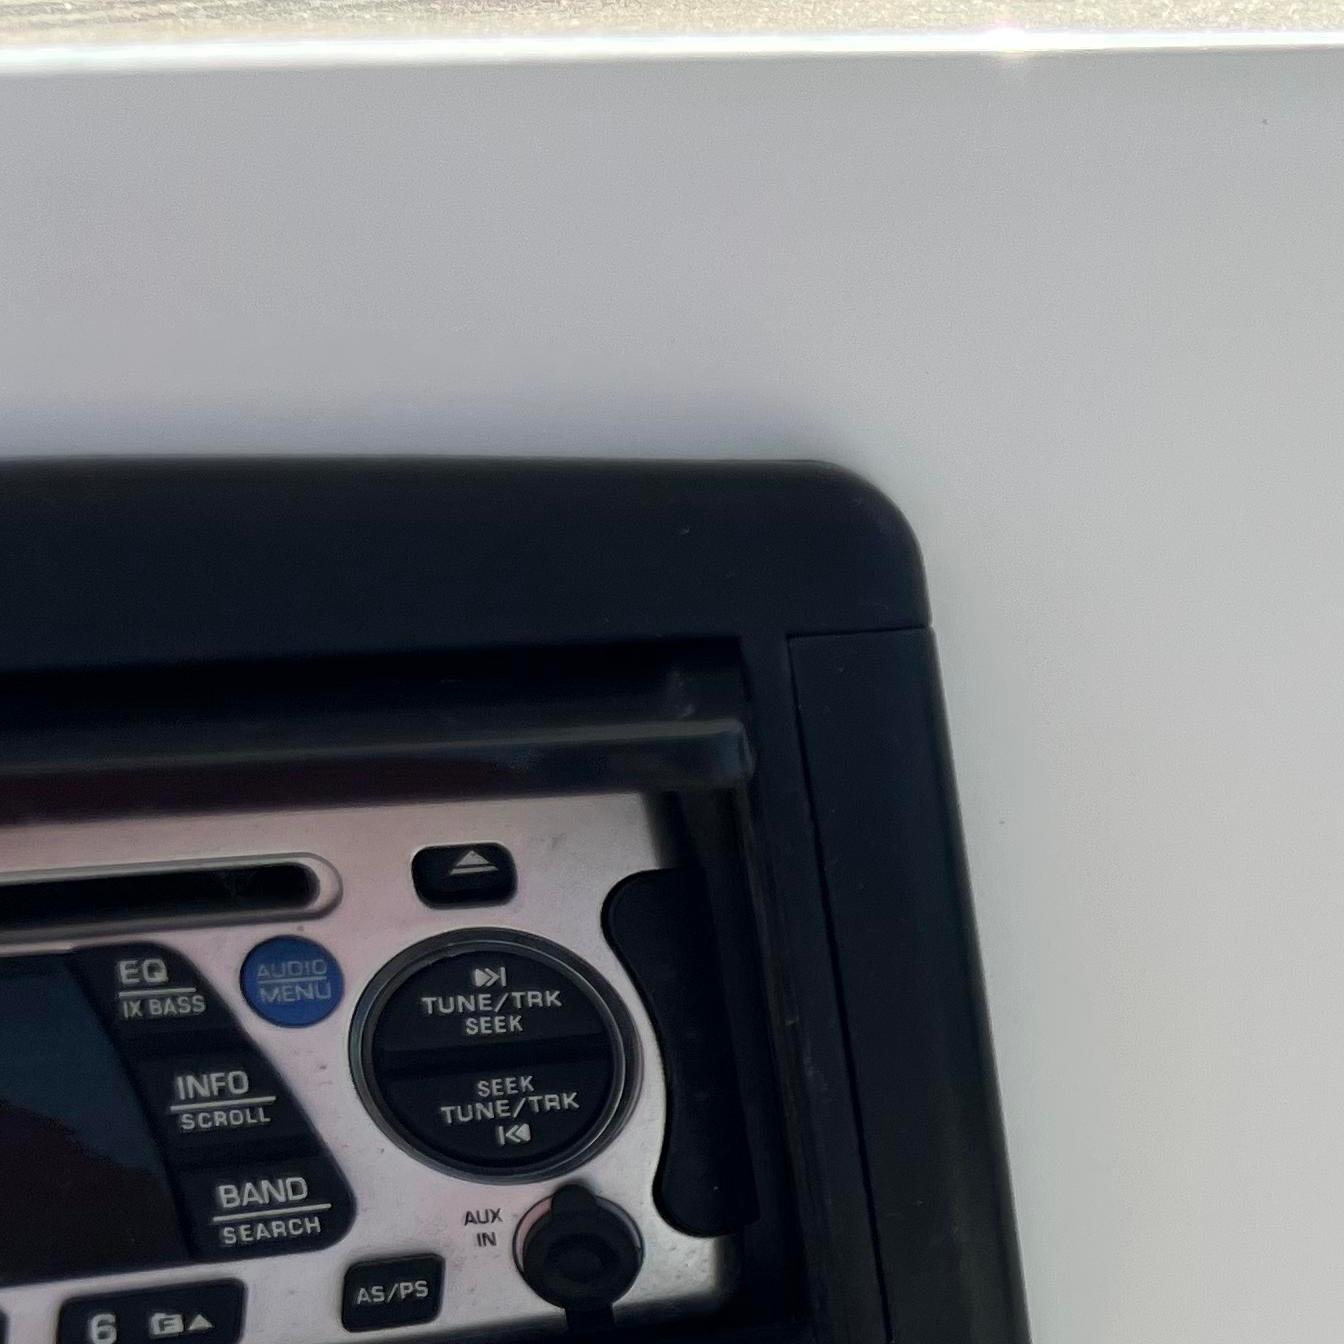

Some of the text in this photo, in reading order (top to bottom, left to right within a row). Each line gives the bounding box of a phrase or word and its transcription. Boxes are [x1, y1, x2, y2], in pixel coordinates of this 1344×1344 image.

[118, 958, 168, 984] EQ
[255, 958, 327, 979] AUDIO
[149, 994, 206, 1016] BASS
[260, 982, 332, 1005] MENU
[421, 990, 562, 1016] TUNE/TRK
[466, 1015, 524, 1035] SEEK
[176, 1070, 249, 1100] INFO
[477, 1075, 535, 1098] SEEK
[181, 1106, 271, 1131] SCROLL
[440, 1092, 580, 1125] TUNE/TRK
[218, 1176, 309, 1208] BAND
[464, 1208, 504, 1226] AUX
[222, 1216, 322, 1245] SEARCH
[476, 1231, 497, 1247] IN
[356, 1279, 429, 1305] AS/PS
